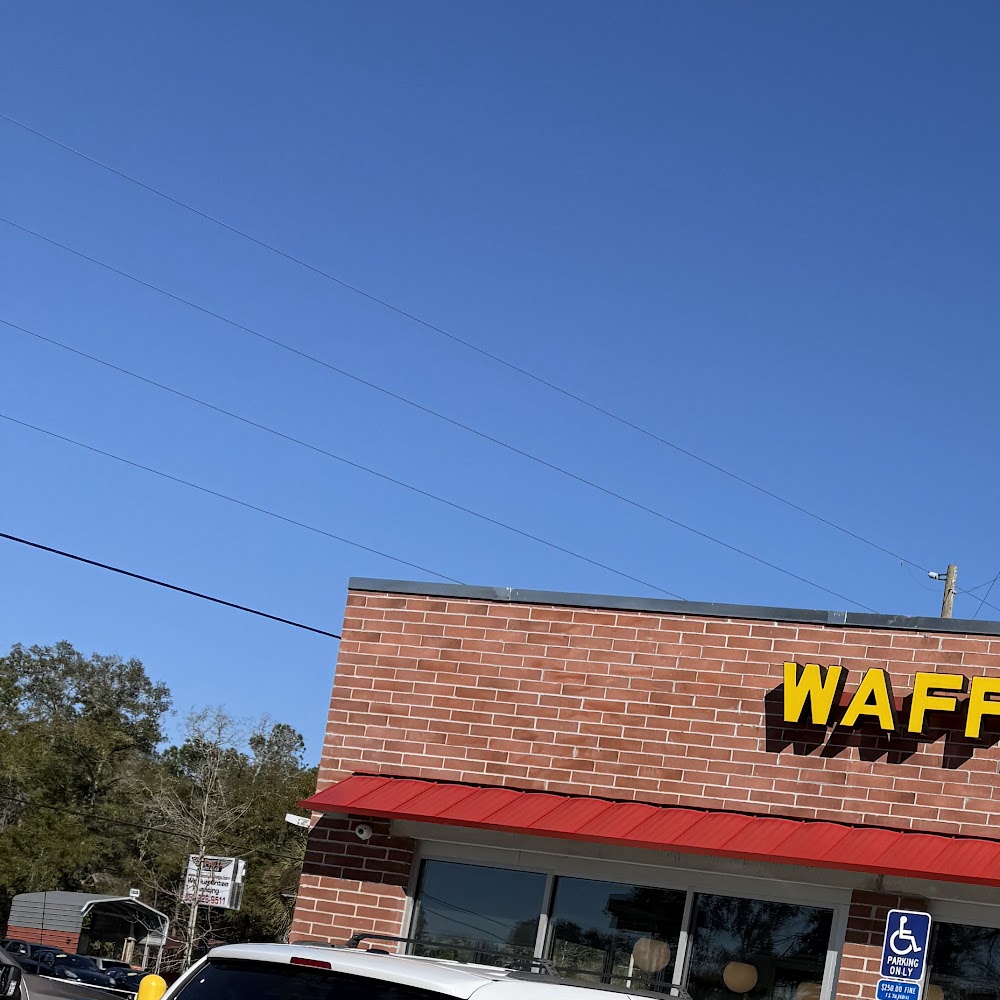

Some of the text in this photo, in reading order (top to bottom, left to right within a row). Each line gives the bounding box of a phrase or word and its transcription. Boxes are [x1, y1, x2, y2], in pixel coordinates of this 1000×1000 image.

[886, 955, 919, 968] PARKING
[889, 966, 913, 977] ONLY
[904, 986, 917, 995] FINE
